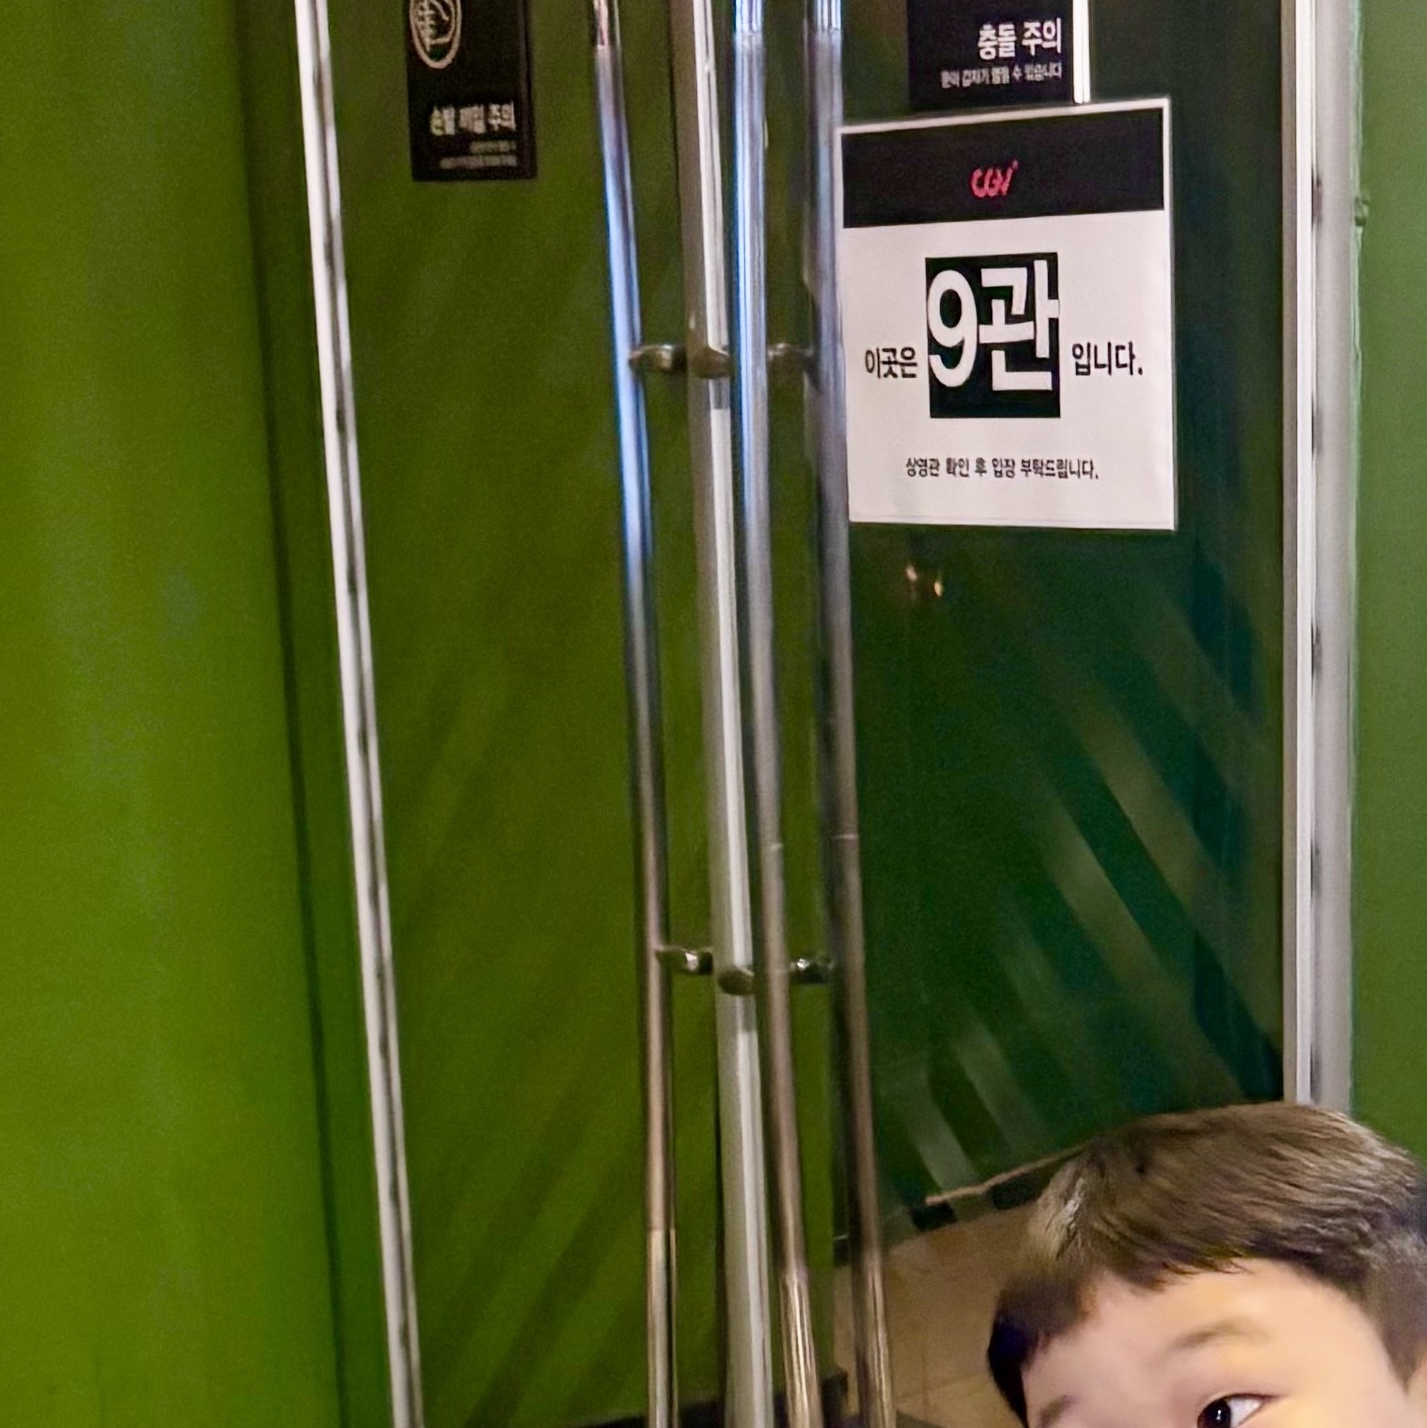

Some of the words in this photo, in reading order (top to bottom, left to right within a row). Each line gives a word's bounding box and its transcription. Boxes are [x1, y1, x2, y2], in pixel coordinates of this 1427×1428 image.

[977, 24, 1017, 60] 충돌
[1022, 17, 1062, 56] 주의
[971, 163, 1016, 198] CGV
[864, 347, 919, 379] 이곳은
[927, 259, 1060, 392] 9관
[1072, 340, 1143, 376] 입니다.
[905, 457, 941, 478] 상영관
[945, 456, 970, 478] 확인
[974, 456, 988, 477] 후
[991, 457, 1016, 479] 입장
[1020, 457, 1099, 480] 부탁드립니다.
